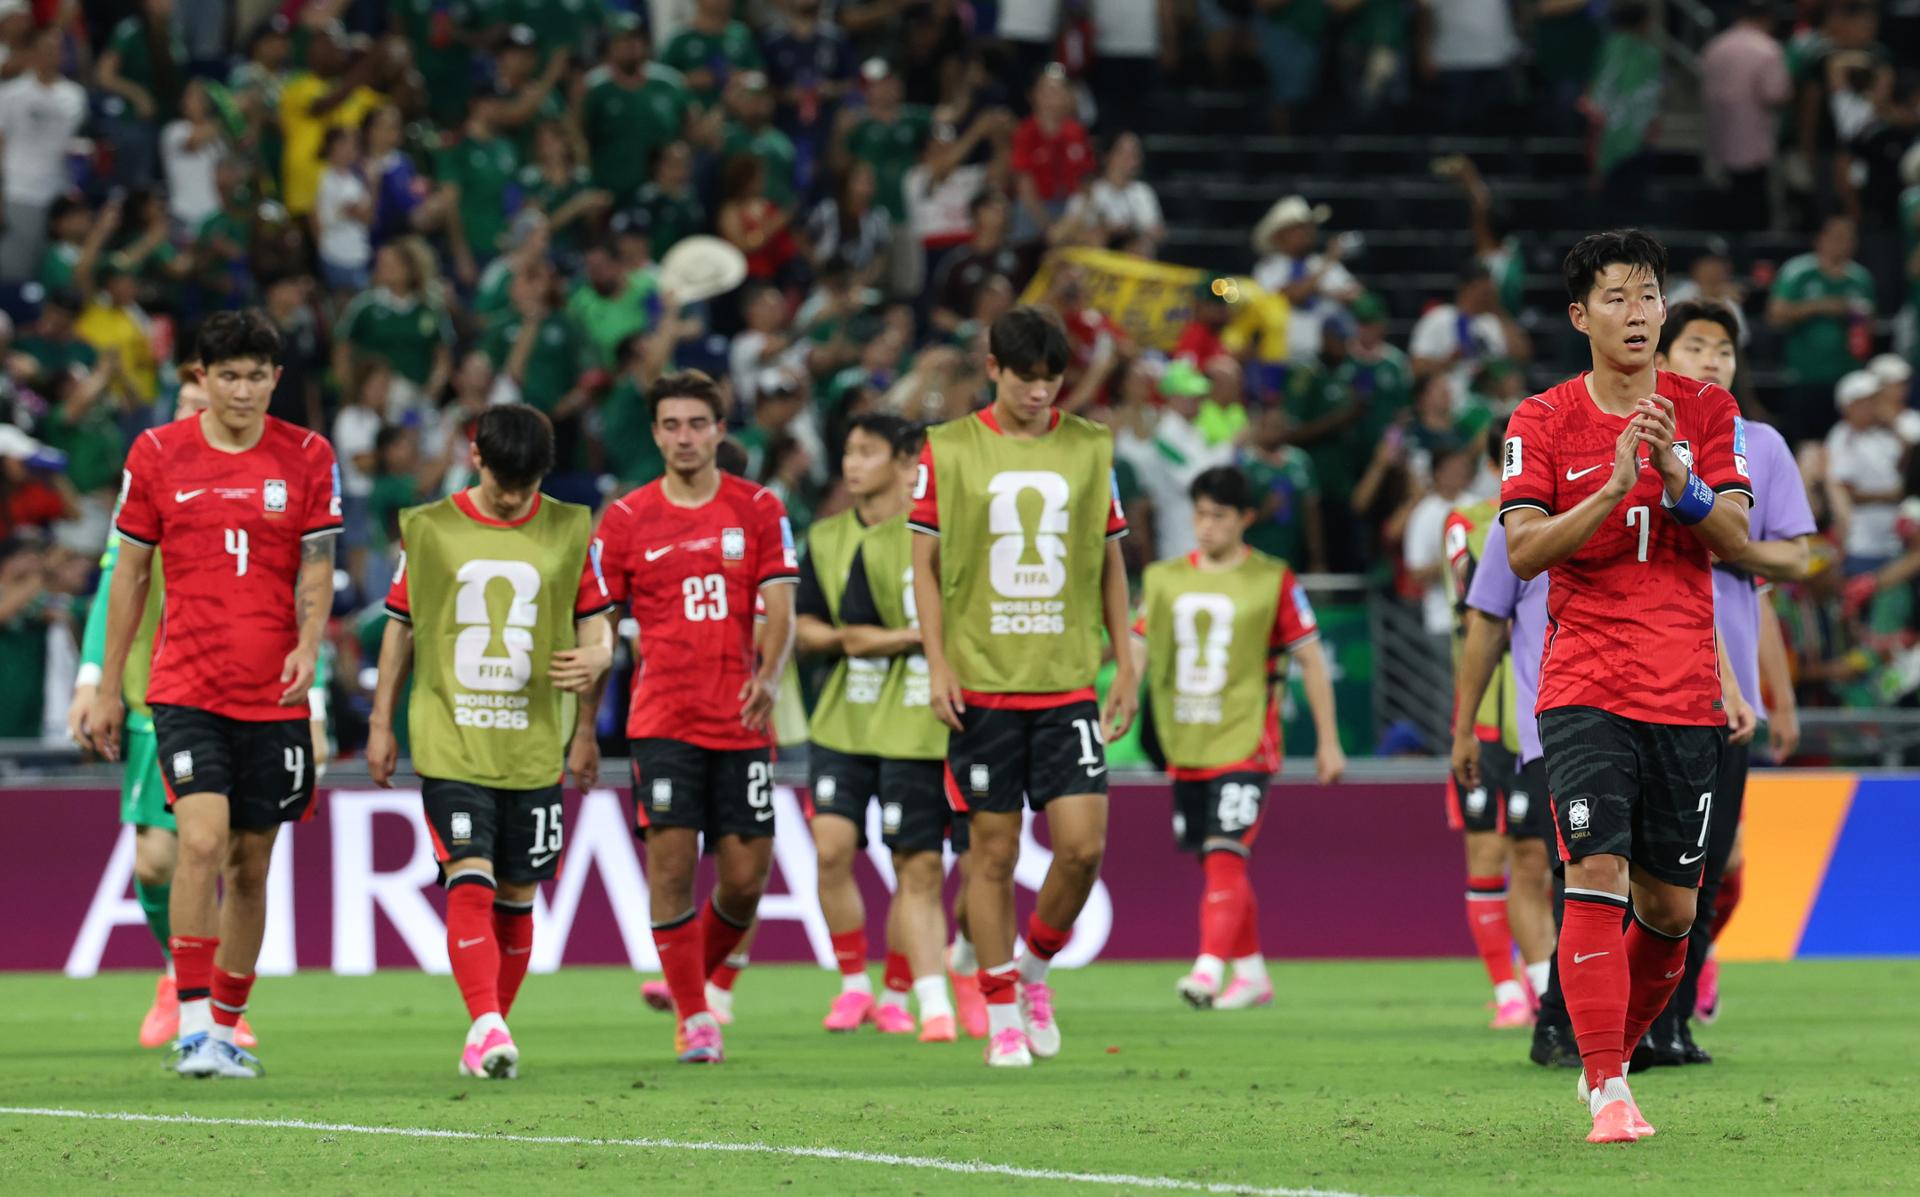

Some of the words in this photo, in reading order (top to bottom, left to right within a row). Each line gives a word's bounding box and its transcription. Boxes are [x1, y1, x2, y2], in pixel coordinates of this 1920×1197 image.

[224, 528, 249, 577] 4
[1626, 505, 1650, 563] 7
[682, 573, 728, 621] 23
[1014, 572, 1048, 585] FIFA
[991, 601, 1042, 614] WORLD
[991, 614, 1065, 634] 2026
[478, 664, 514, 678] FIFA
[454, 693, 505, 708] WORLD
[454, 706, 529, 730] 2026
[284, 746, 305, 792] 4
[1217, 782, 1261, 826] 26
[1696, 792, 1712, 847] 7
[528, 803, 563, 855] 15
